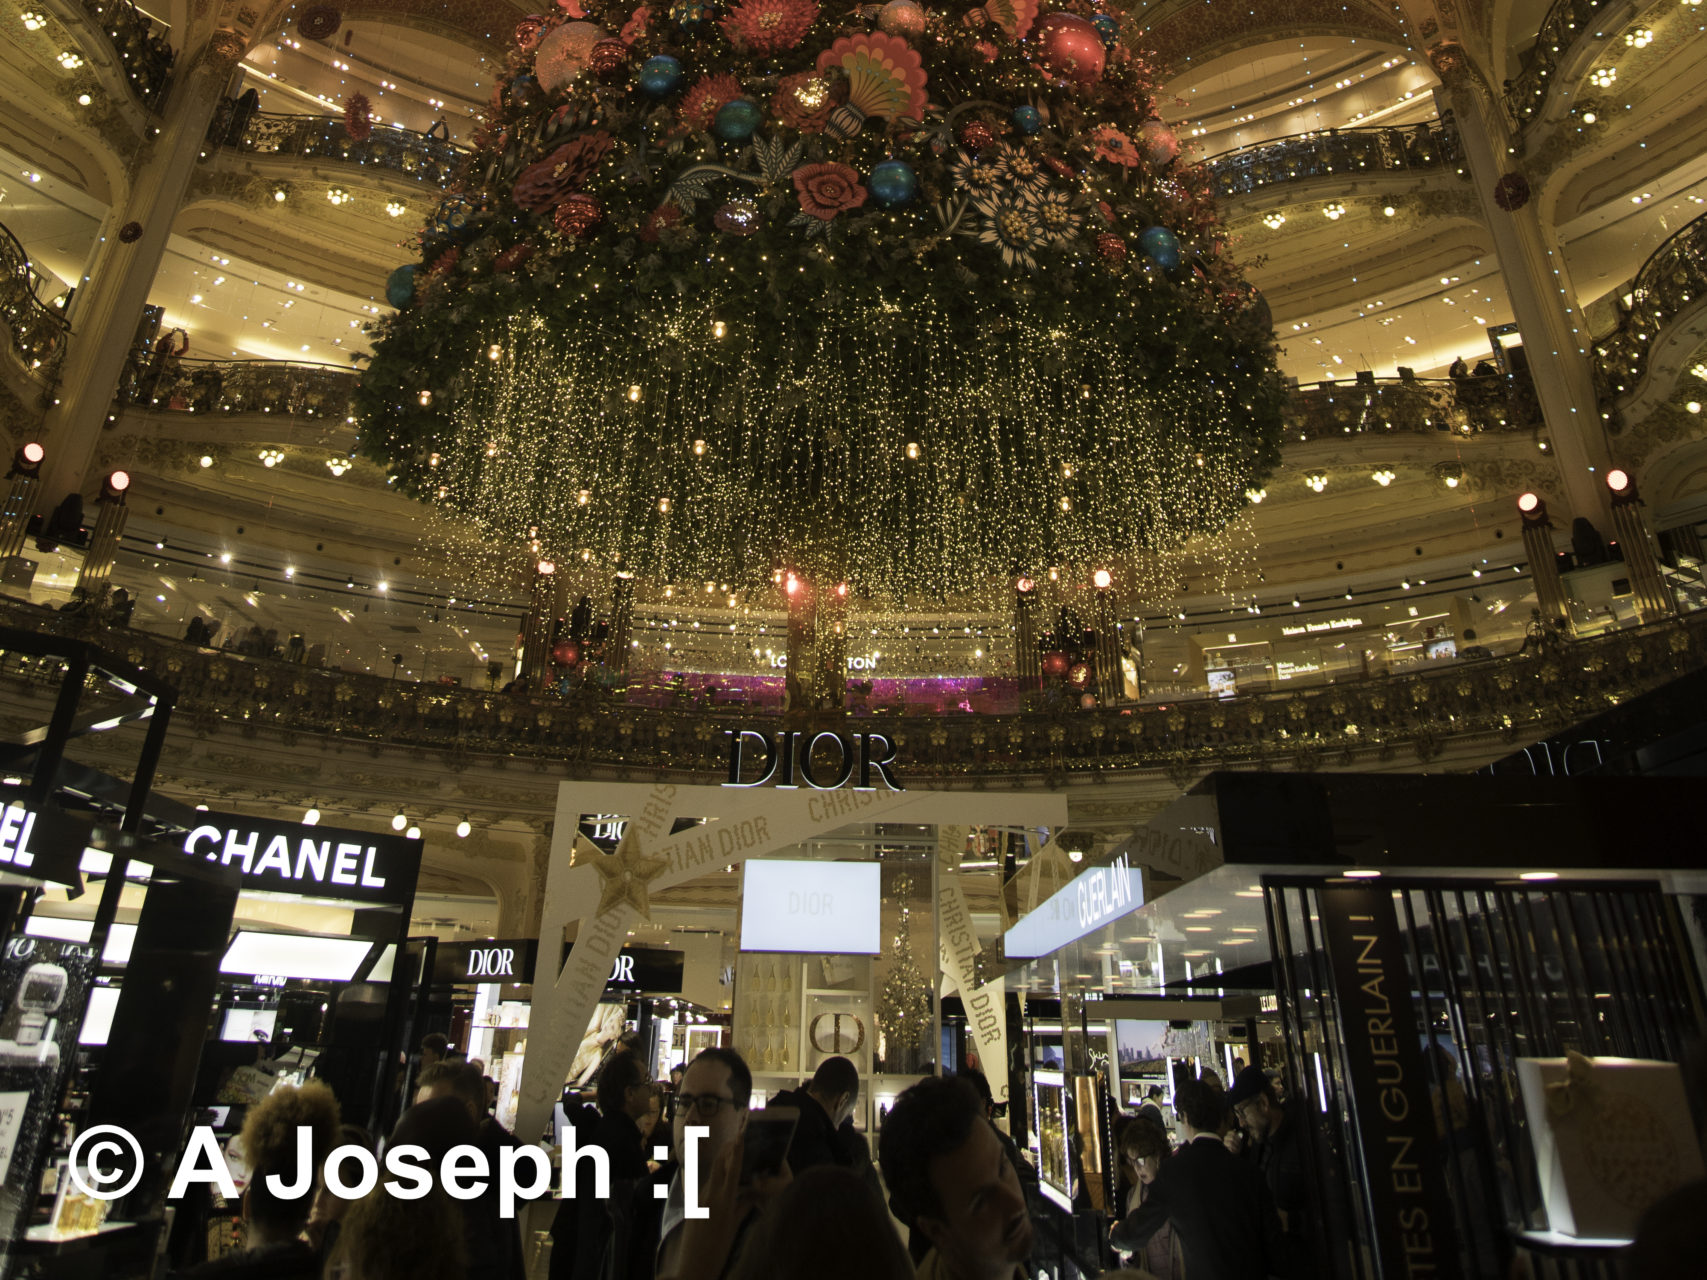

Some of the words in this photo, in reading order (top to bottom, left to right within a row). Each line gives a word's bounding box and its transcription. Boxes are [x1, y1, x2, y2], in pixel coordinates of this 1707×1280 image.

[847, 657, 876, 669] TON
[721, 729, 905, 792] DIOR
[0, 802, 38, 868] EL
[185, 825, 386, 889] CHANEL
[718, 815, 771, 856] DIOR
[787, 890, 835, 916] DIOR
[1077, 851, 1132, 929] GUERLAIN
[466, 947, 515, 976] DIOR
[970, 993, 1002, 1046] DIOR
[1351, 934, 1410, 1124] GUERLAIN
[1386, 1134, 1425, 1195] EN
[1399, 1207, 1438, 1280] TES
